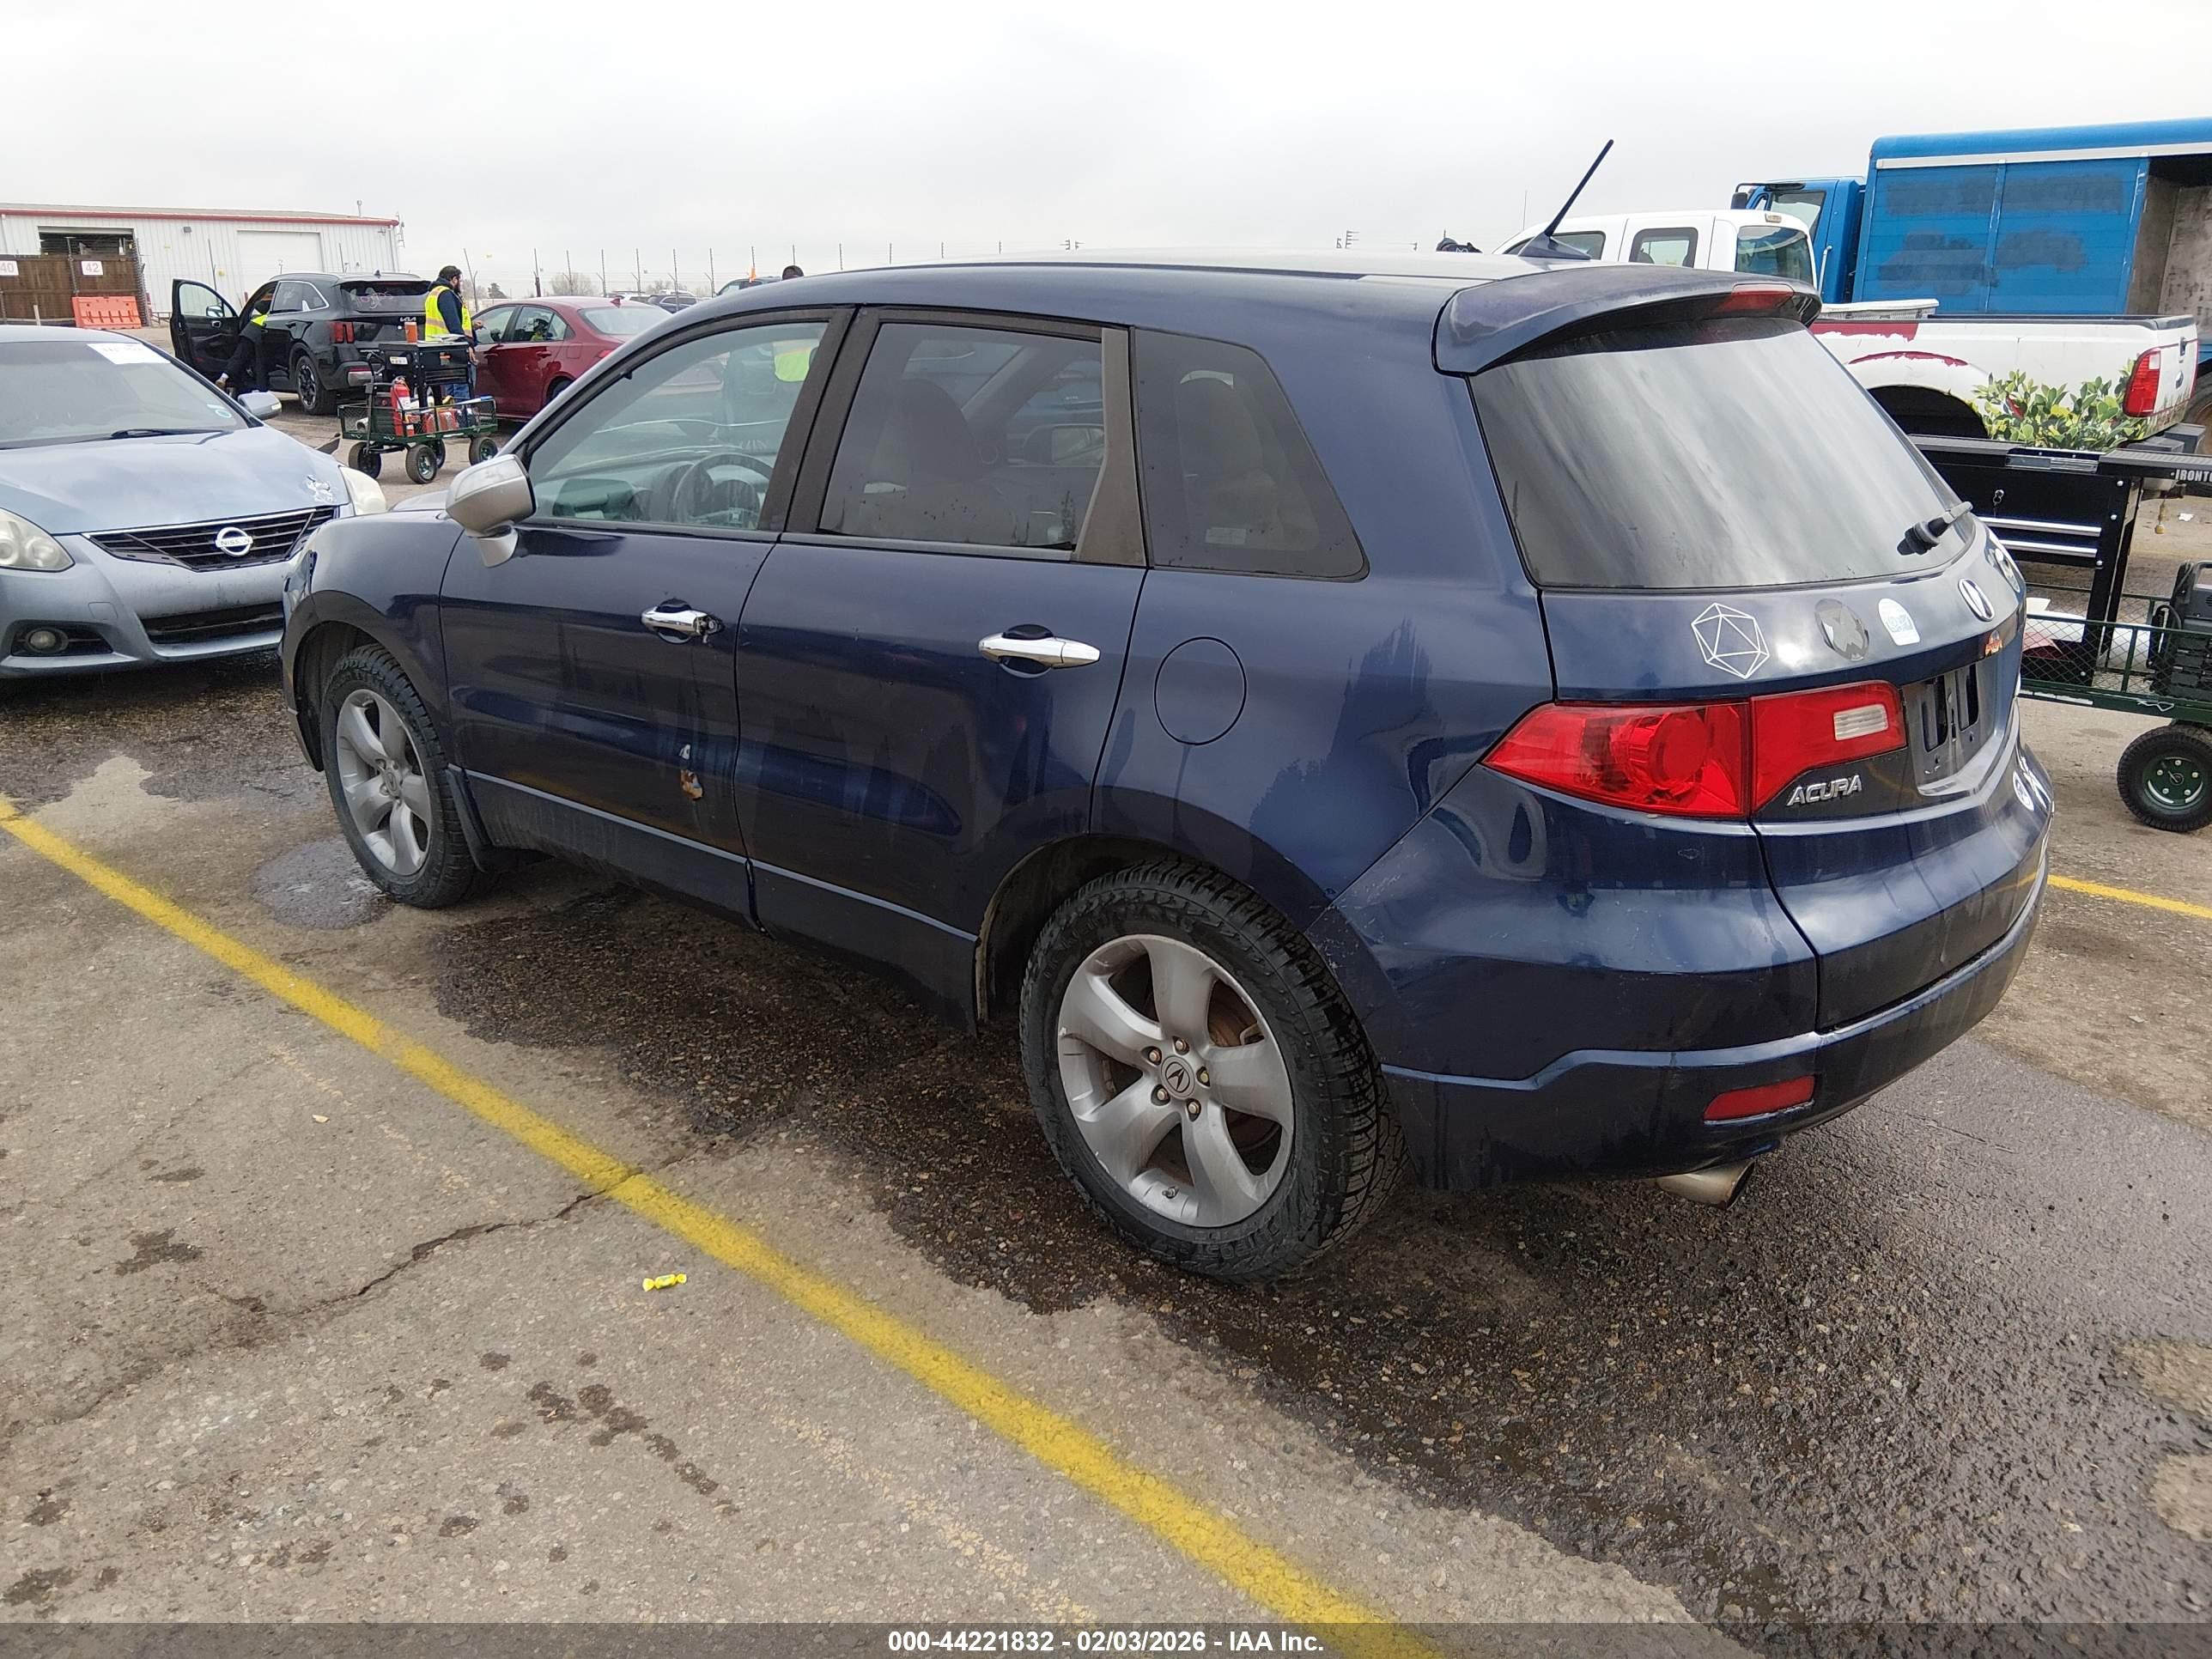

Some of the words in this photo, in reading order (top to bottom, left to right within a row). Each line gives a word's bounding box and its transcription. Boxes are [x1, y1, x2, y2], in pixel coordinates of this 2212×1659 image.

[0, 262, 15, 273] 40
[86, 263, 99, 273] 42
[1786, 775, 1863, 806] ACURA
